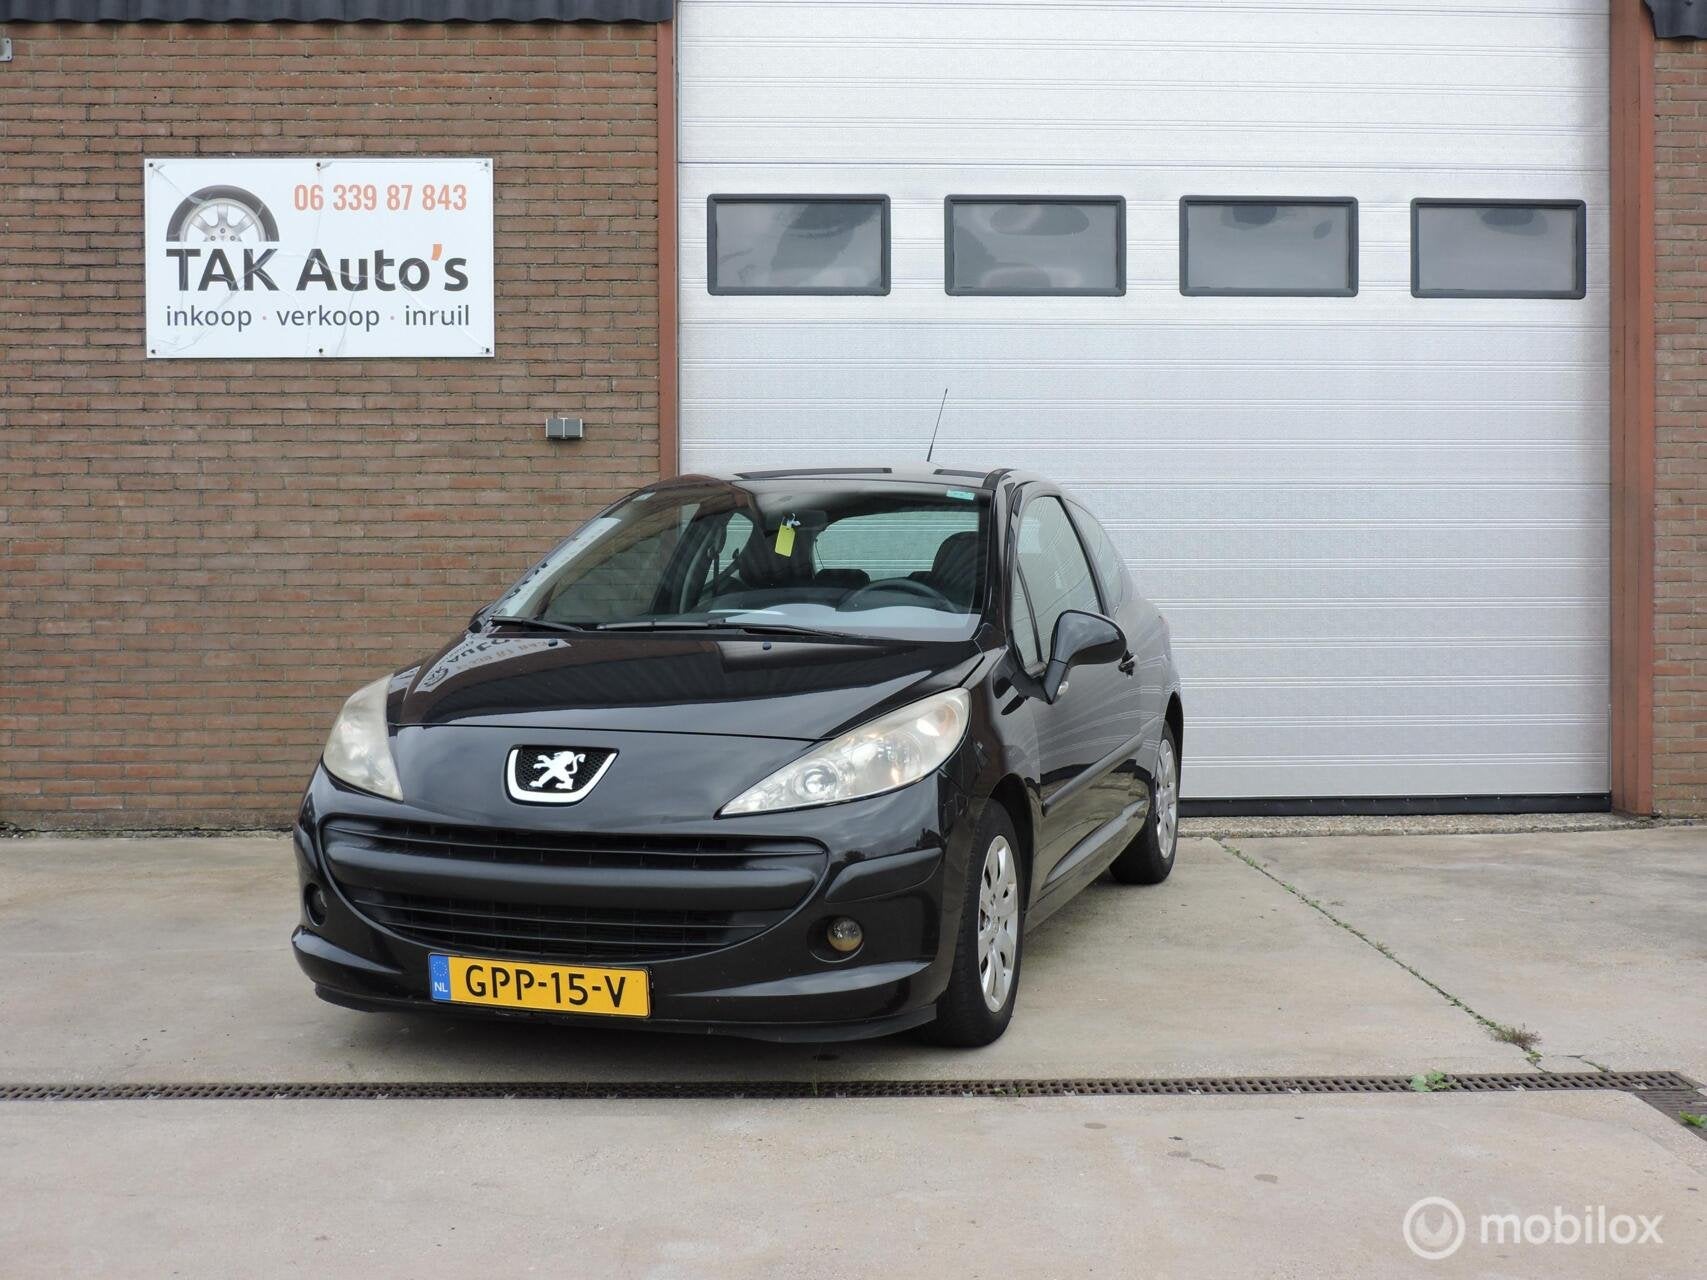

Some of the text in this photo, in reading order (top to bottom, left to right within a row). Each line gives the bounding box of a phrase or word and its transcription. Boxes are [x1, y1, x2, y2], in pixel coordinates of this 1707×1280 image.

[294, 184, 467, 211] 06 339 87 843
[166, 243, 469, 292] TAK Auto's
[166, 305, 470, 332] inkoop verkoop inruil
[434, 981, 448, 993] NL
[465, 964, 626, 1008] GPP-15-V
